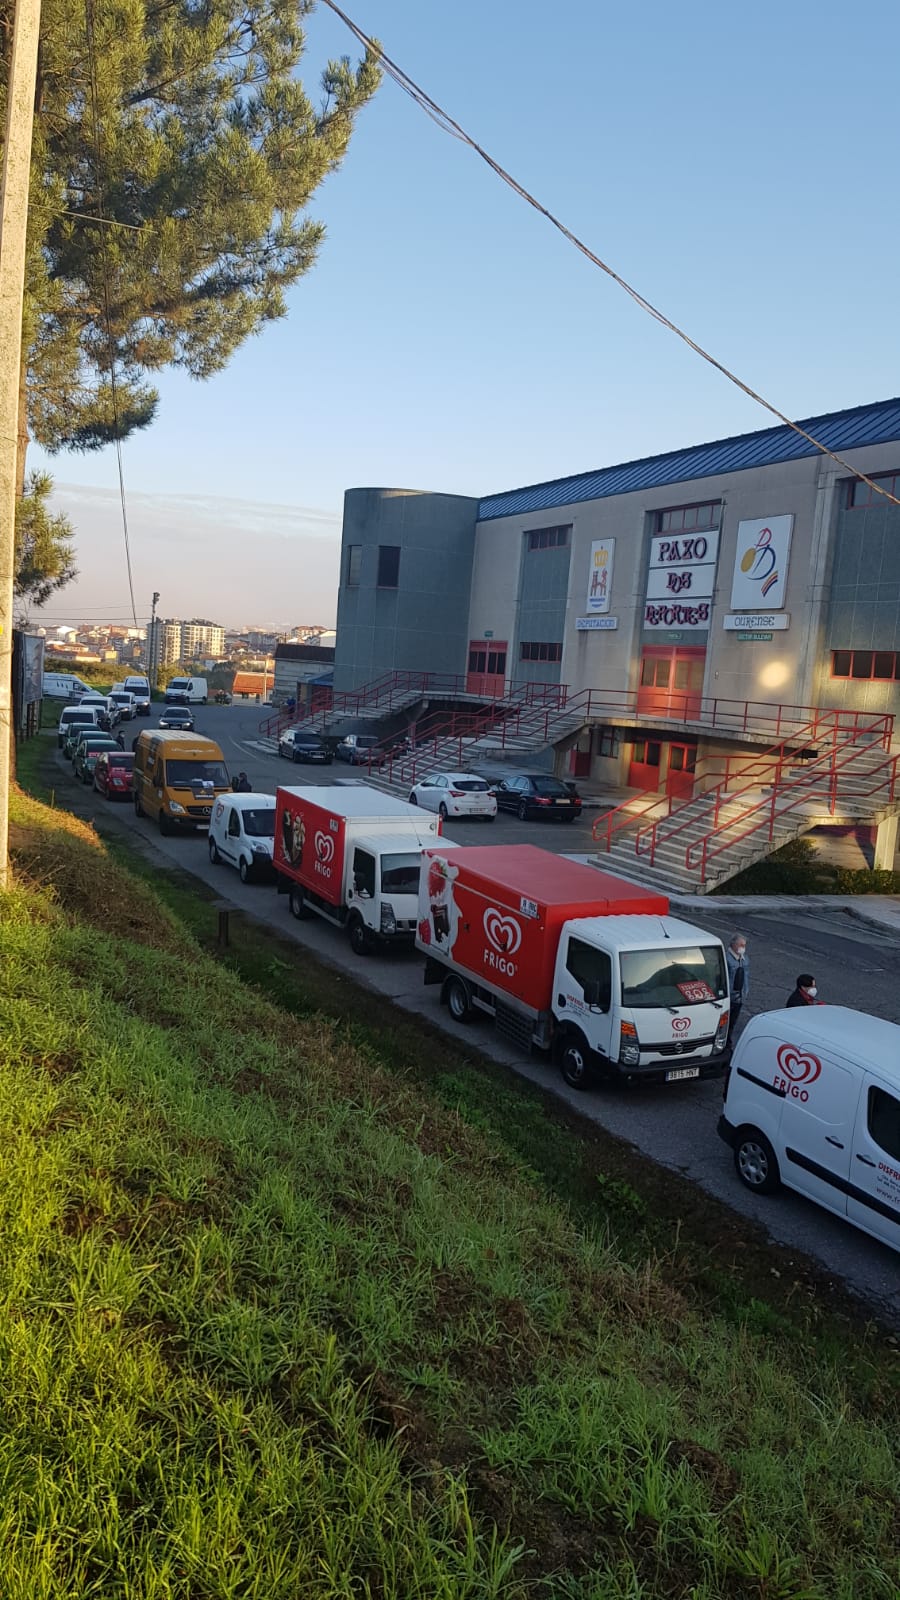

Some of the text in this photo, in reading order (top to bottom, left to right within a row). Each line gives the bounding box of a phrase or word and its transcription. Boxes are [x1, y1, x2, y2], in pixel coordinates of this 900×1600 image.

[658, 537, 708, 561] PAZO
[666, 572, 693, 593] DOS
[644, 603, 710, 625] DEPORTES
[734, 615, 775, 629] OURENSE
[314, 860, 331, 879] FRIGO
[483, 949, 515, 977] FRIGO
[672, 1031, 689, 1039] FRIGO
[773, 1076, 809, 1103] FRIGO
